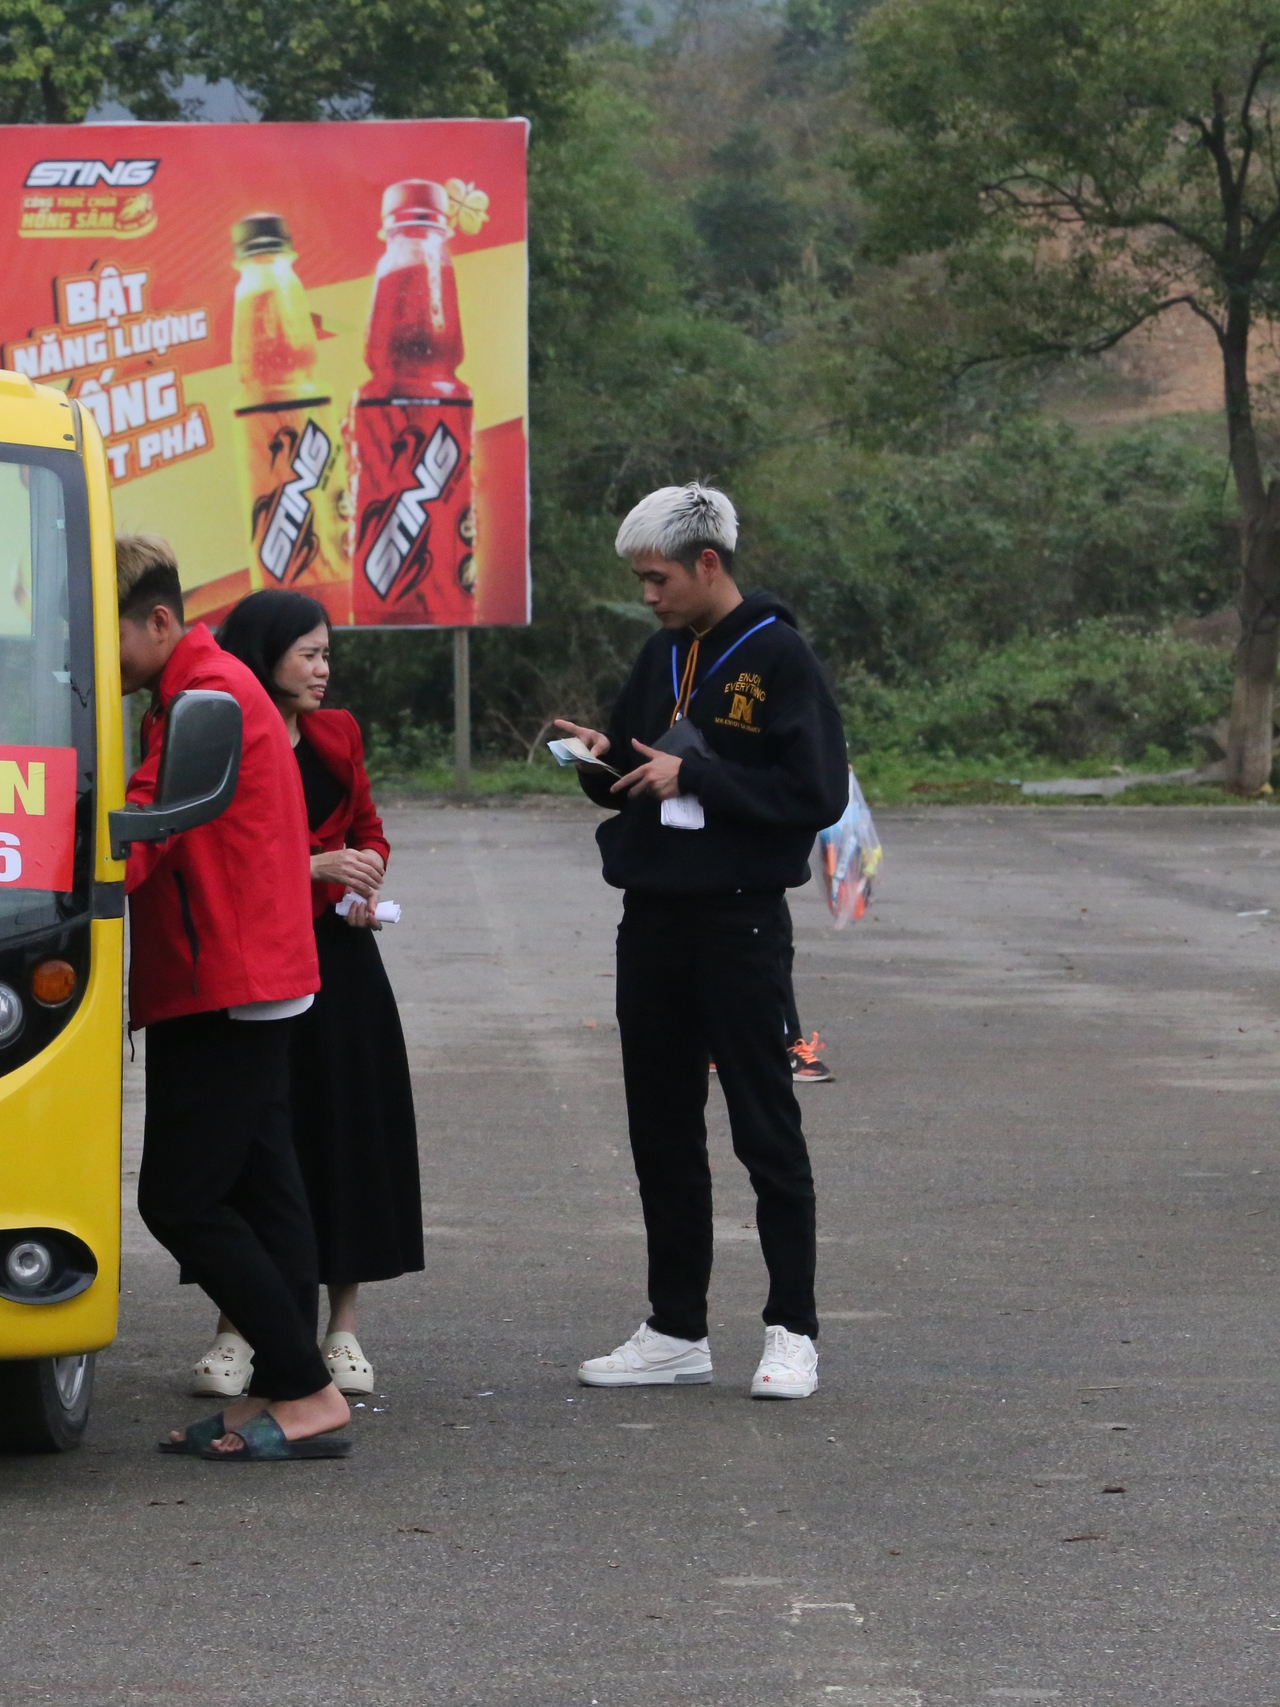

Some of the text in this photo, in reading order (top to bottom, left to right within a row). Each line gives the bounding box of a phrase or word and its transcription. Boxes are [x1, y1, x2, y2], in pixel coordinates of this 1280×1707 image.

[23, 159, 161, 188] STING
[65, 266, 148, 327] BẬT
[13, 309, 208, 379] NĂNG LƯỢNG
[137, 409, 208, 470] PHÁ
[259, 417, 332, 583] STING
[364, 418, 461, 603] STING
